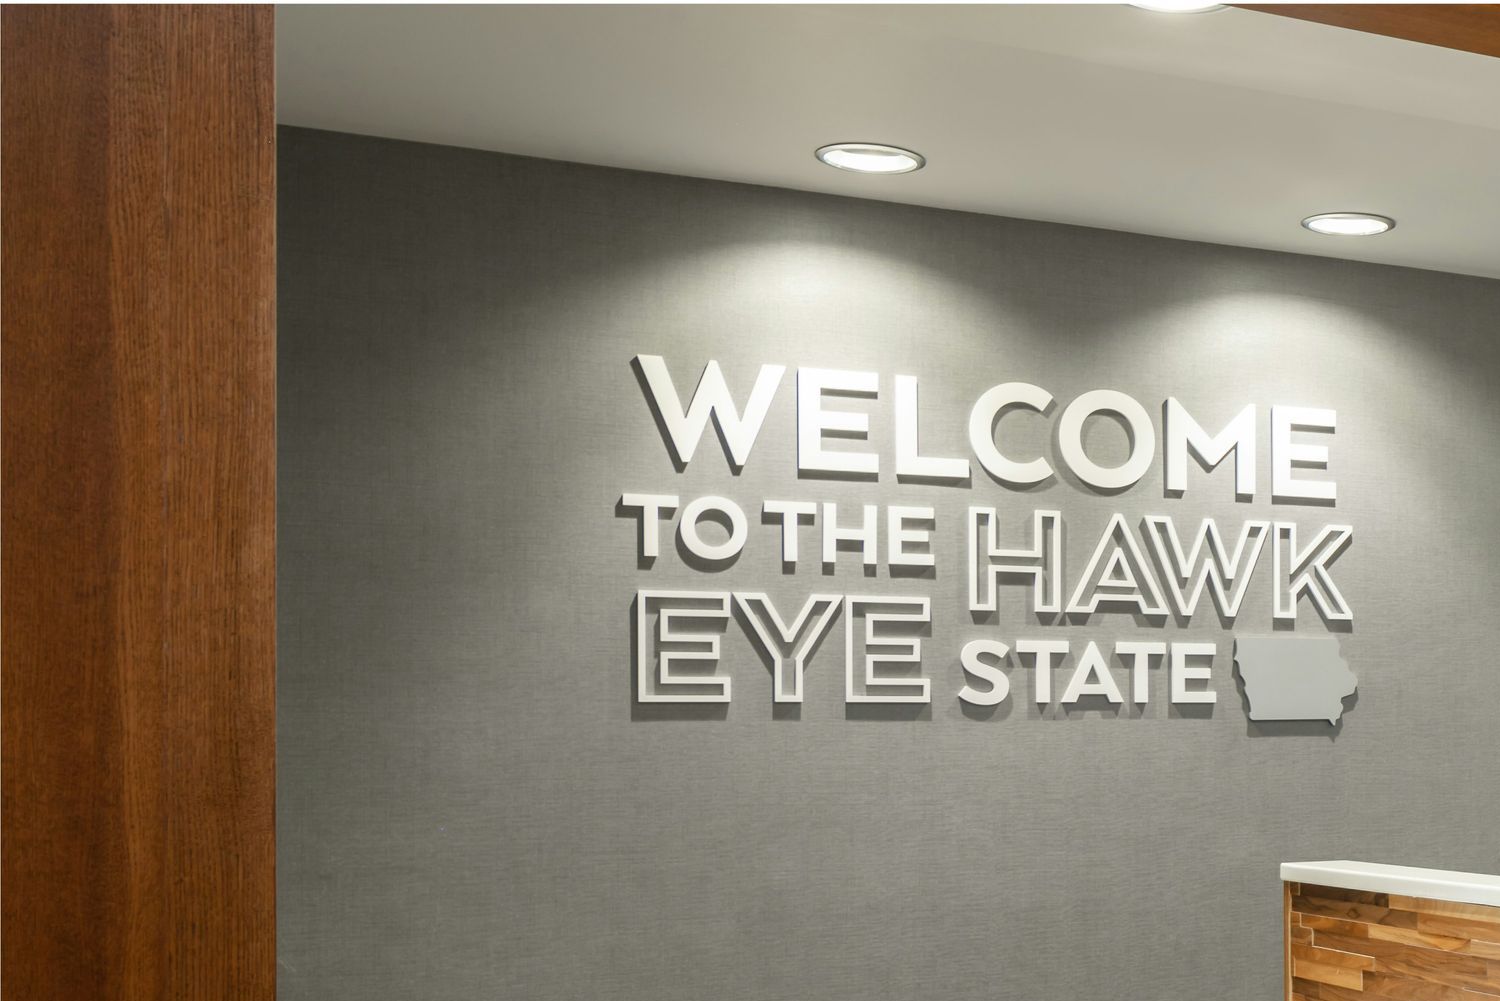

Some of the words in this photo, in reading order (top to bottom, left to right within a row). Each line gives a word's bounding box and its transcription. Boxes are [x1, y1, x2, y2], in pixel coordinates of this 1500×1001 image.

[637, 353, 1337, 500] WELCOME
[622, 492, 748, 561] TO
[763, 499, 935, 566] THE
[968, 506, 1353, 621] HAWK
[637, 589, 931, 704] EYE
[957, 639, 1218, 706] STATE
